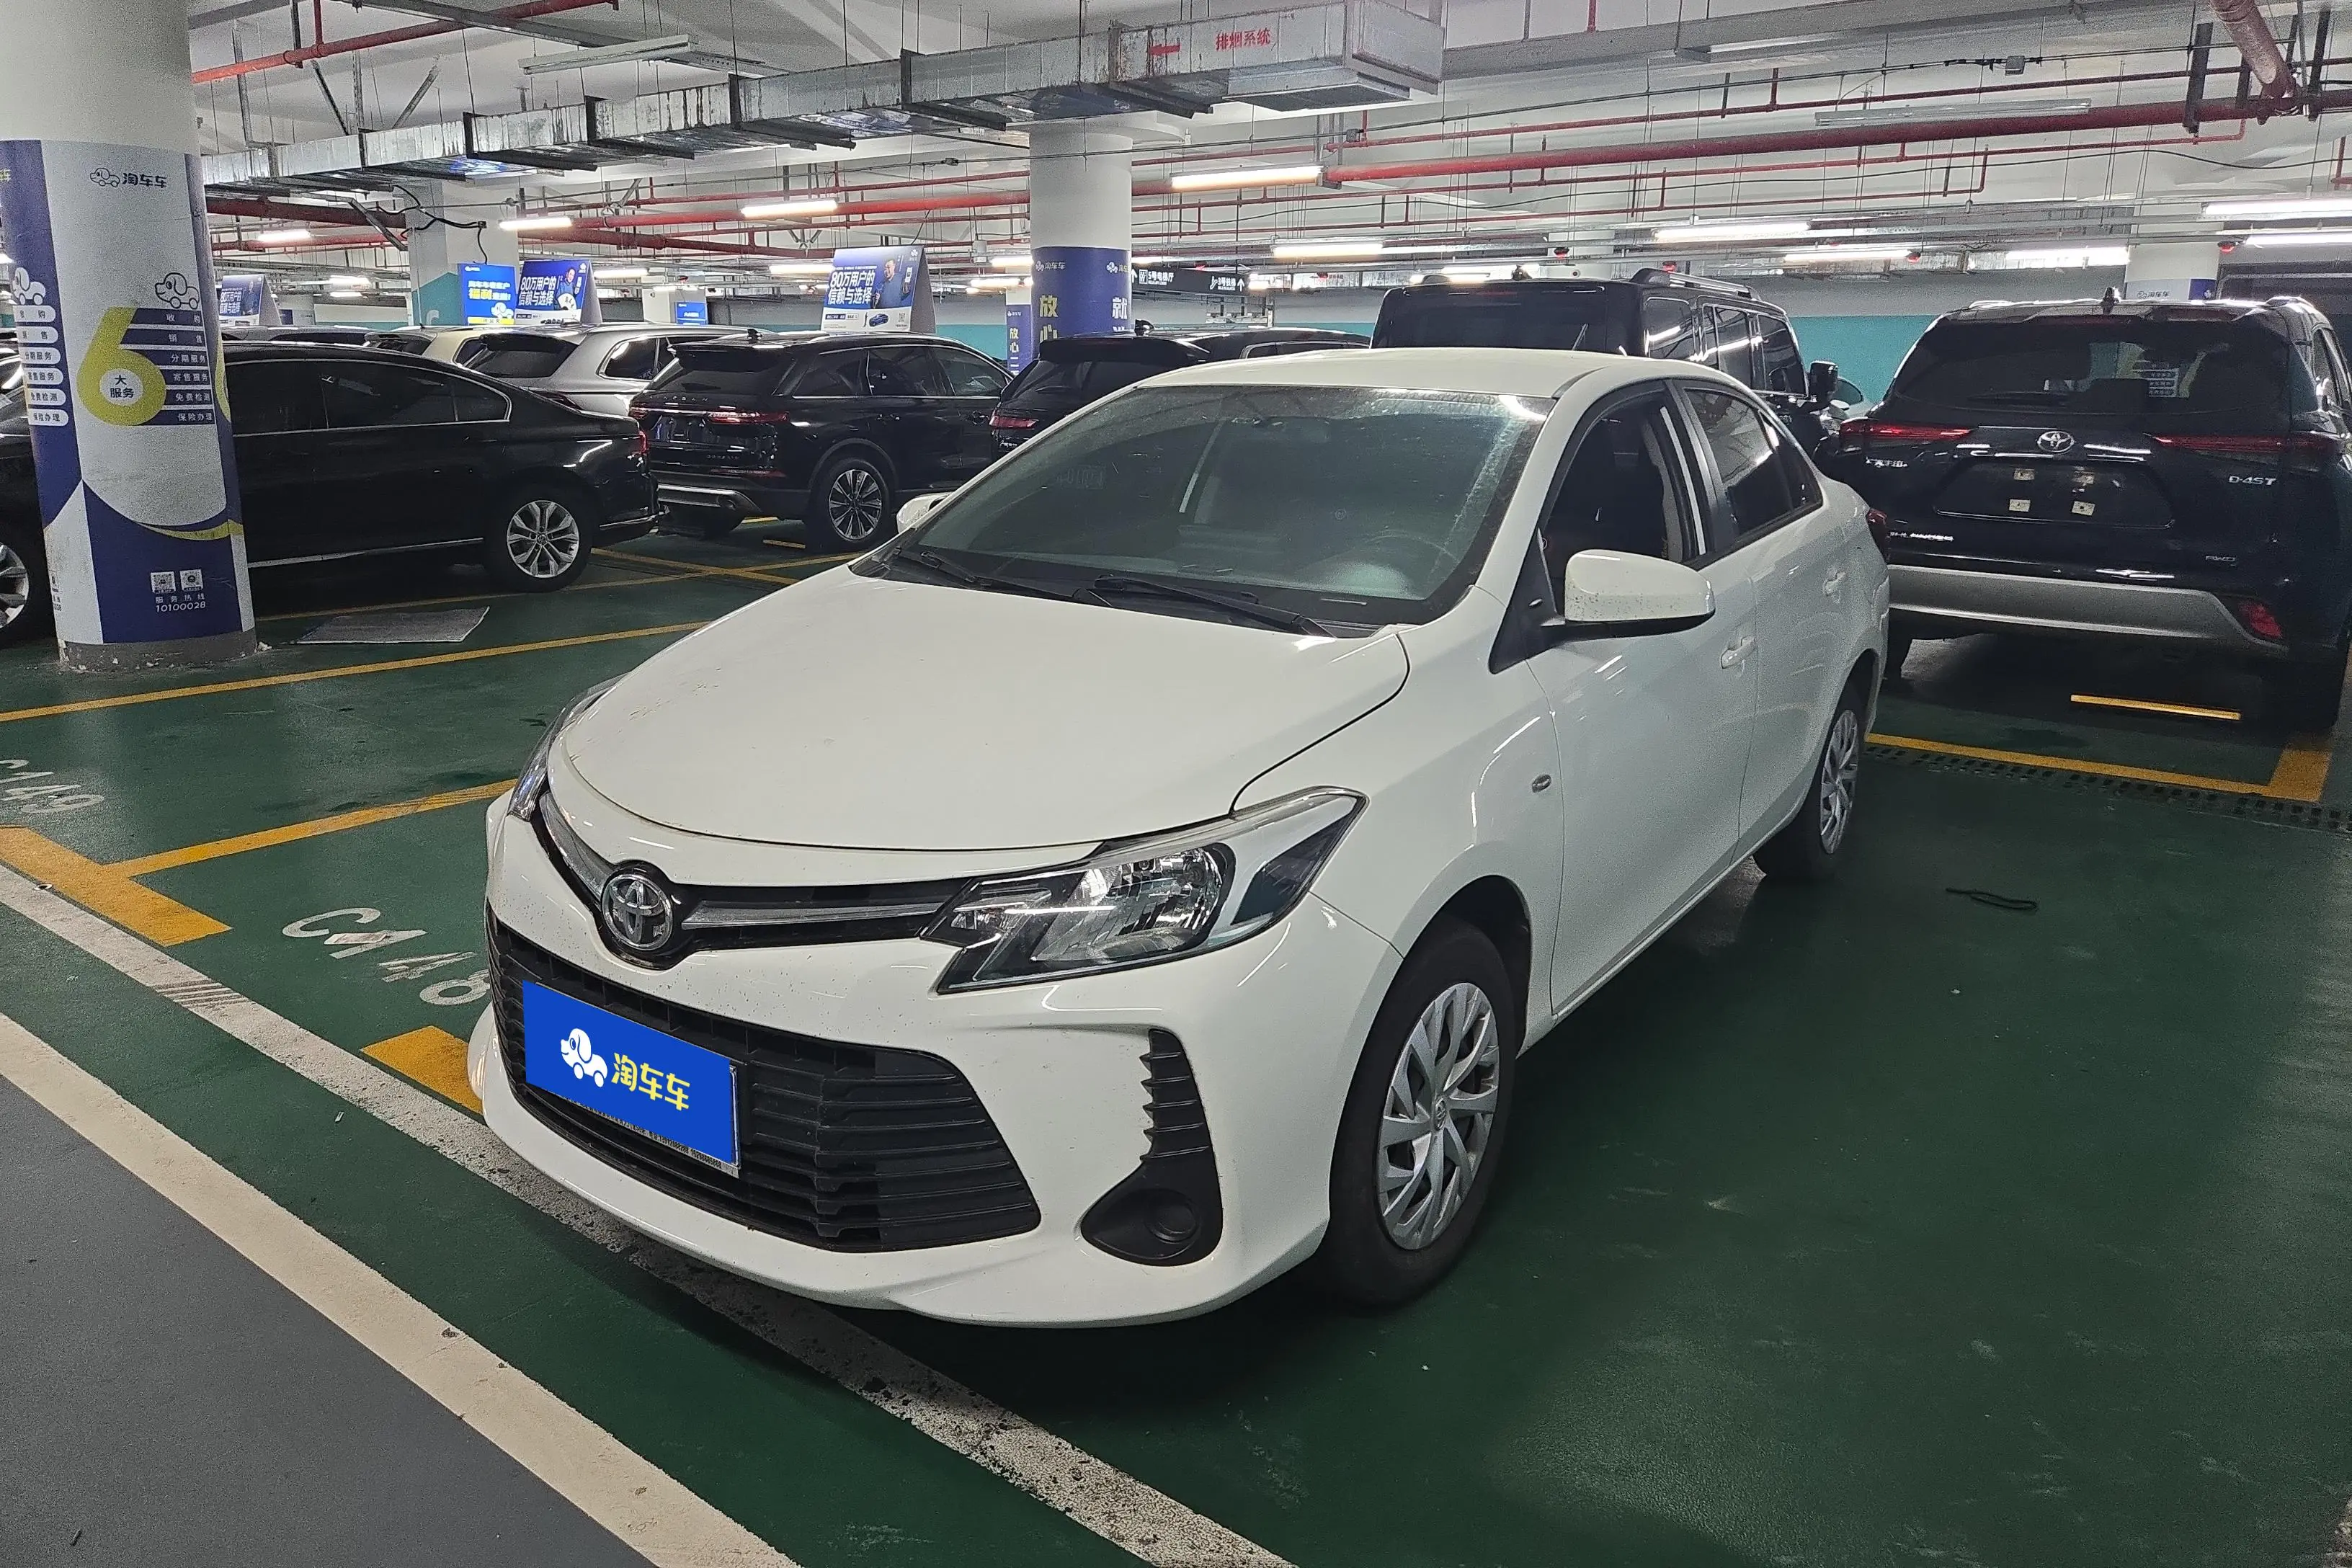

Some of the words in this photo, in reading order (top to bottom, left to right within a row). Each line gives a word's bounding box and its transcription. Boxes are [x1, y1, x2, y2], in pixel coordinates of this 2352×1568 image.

[1215, 28, 1270, 50] 排烟系统
[122, 172, 167, 188] 淘车车
[1045, 262, 1066, 270] 淘车车
[520, 275, 557, 291] 80万用户的
[830, 270, 876, 288] 80万用户的
[518, 290, 555, 306] 信赖与选择
[828, 287, 872, 305] 信赖与选择
[166, 313, 200, 324] 收购
[168, 334, 202, 343] 销售
[171, 354, 207, 363] 分期服务
[115, 375, 128, 386] 大
[173, 373, 208, 382] 寄售服务
[110, 388, 135, 398] 服务
[175, 393, 210, 402] 免费检测
[178, 413, 213, 422] 保险办理
[2229, 476, 2276, 485] D-4ST
[156, 600, 206, 612] 10100028
